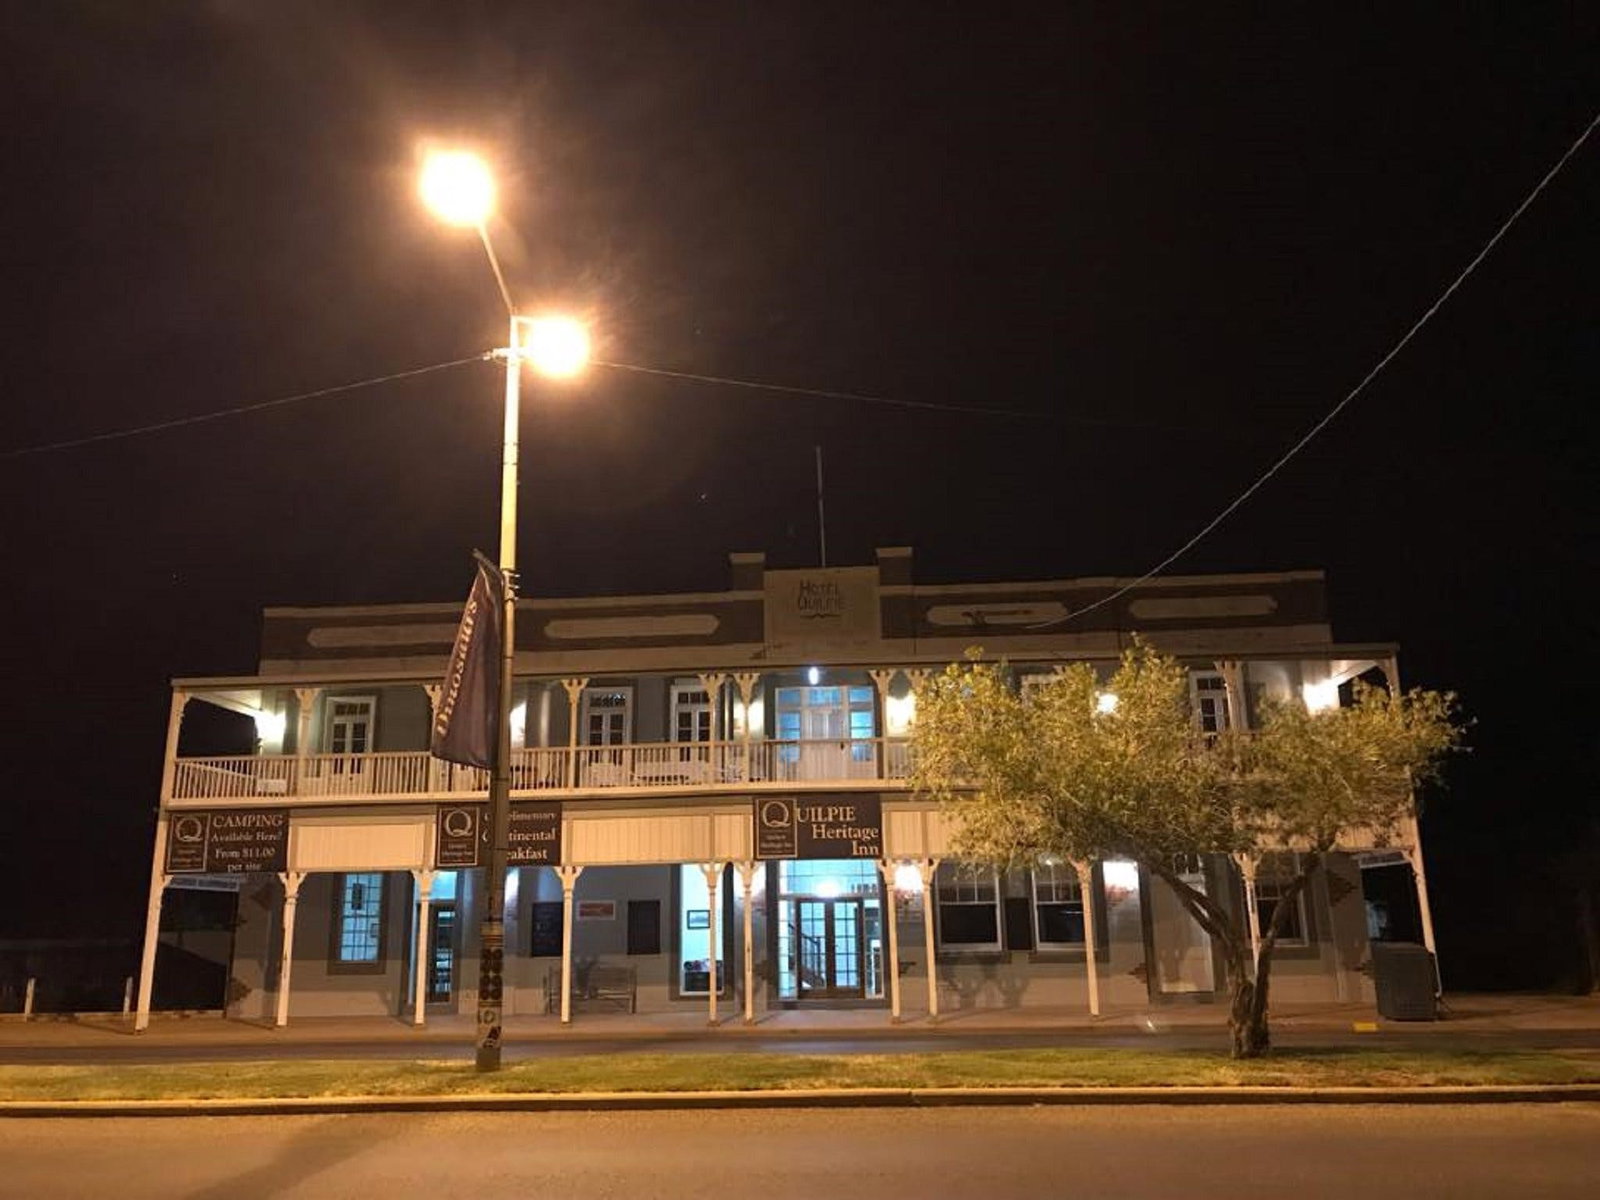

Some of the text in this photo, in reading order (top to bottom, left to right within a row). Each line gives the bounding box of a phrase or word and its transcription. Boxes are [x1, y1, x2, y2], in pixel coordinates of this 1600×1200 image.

[212, 814, 283, 828] CAMPING
[812, 823, 879, 840] Heritage
[852, 840, 879, 855] Inn
